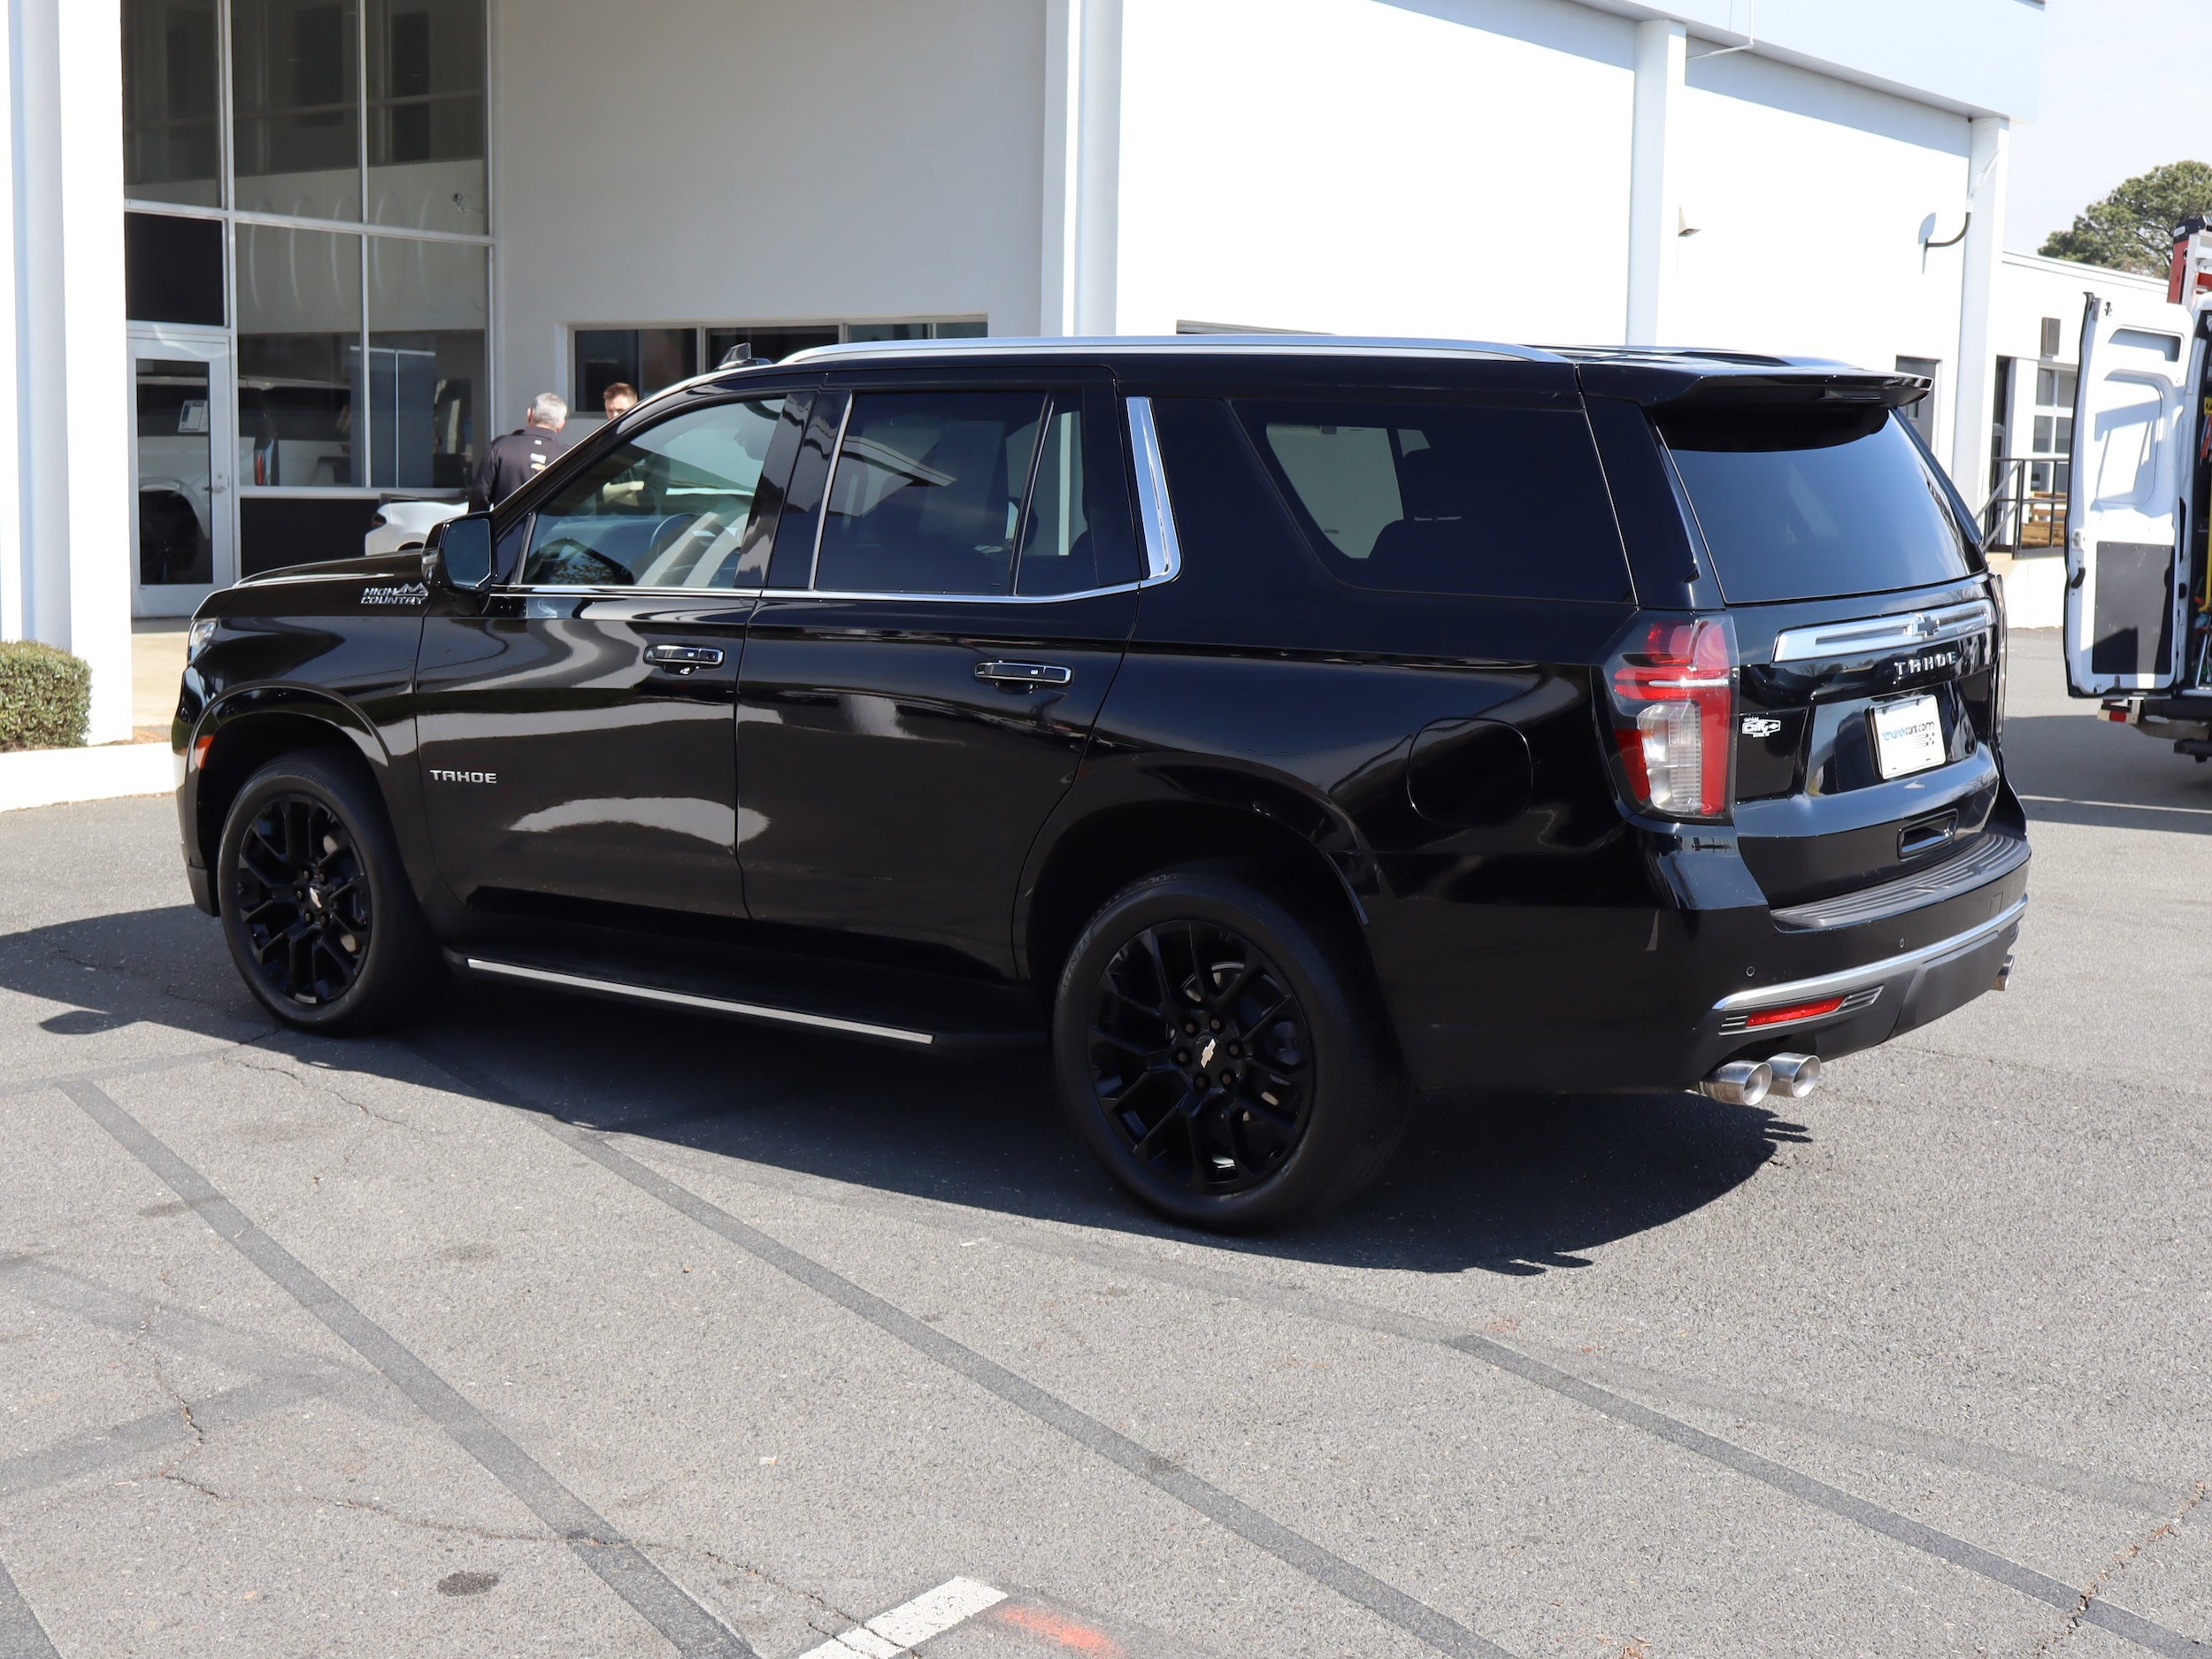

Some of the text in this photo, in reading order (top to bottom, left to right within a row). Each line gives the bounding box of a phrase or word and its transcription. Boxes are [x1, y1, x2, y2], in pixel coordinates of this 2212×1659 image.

[363, 587, 398, 596] HIGH
[360, 595, 426, 605] COUNTRY
[1893, 651, 1956, 675] TAHOE
[429, 769, 497, 784] TAHOE
